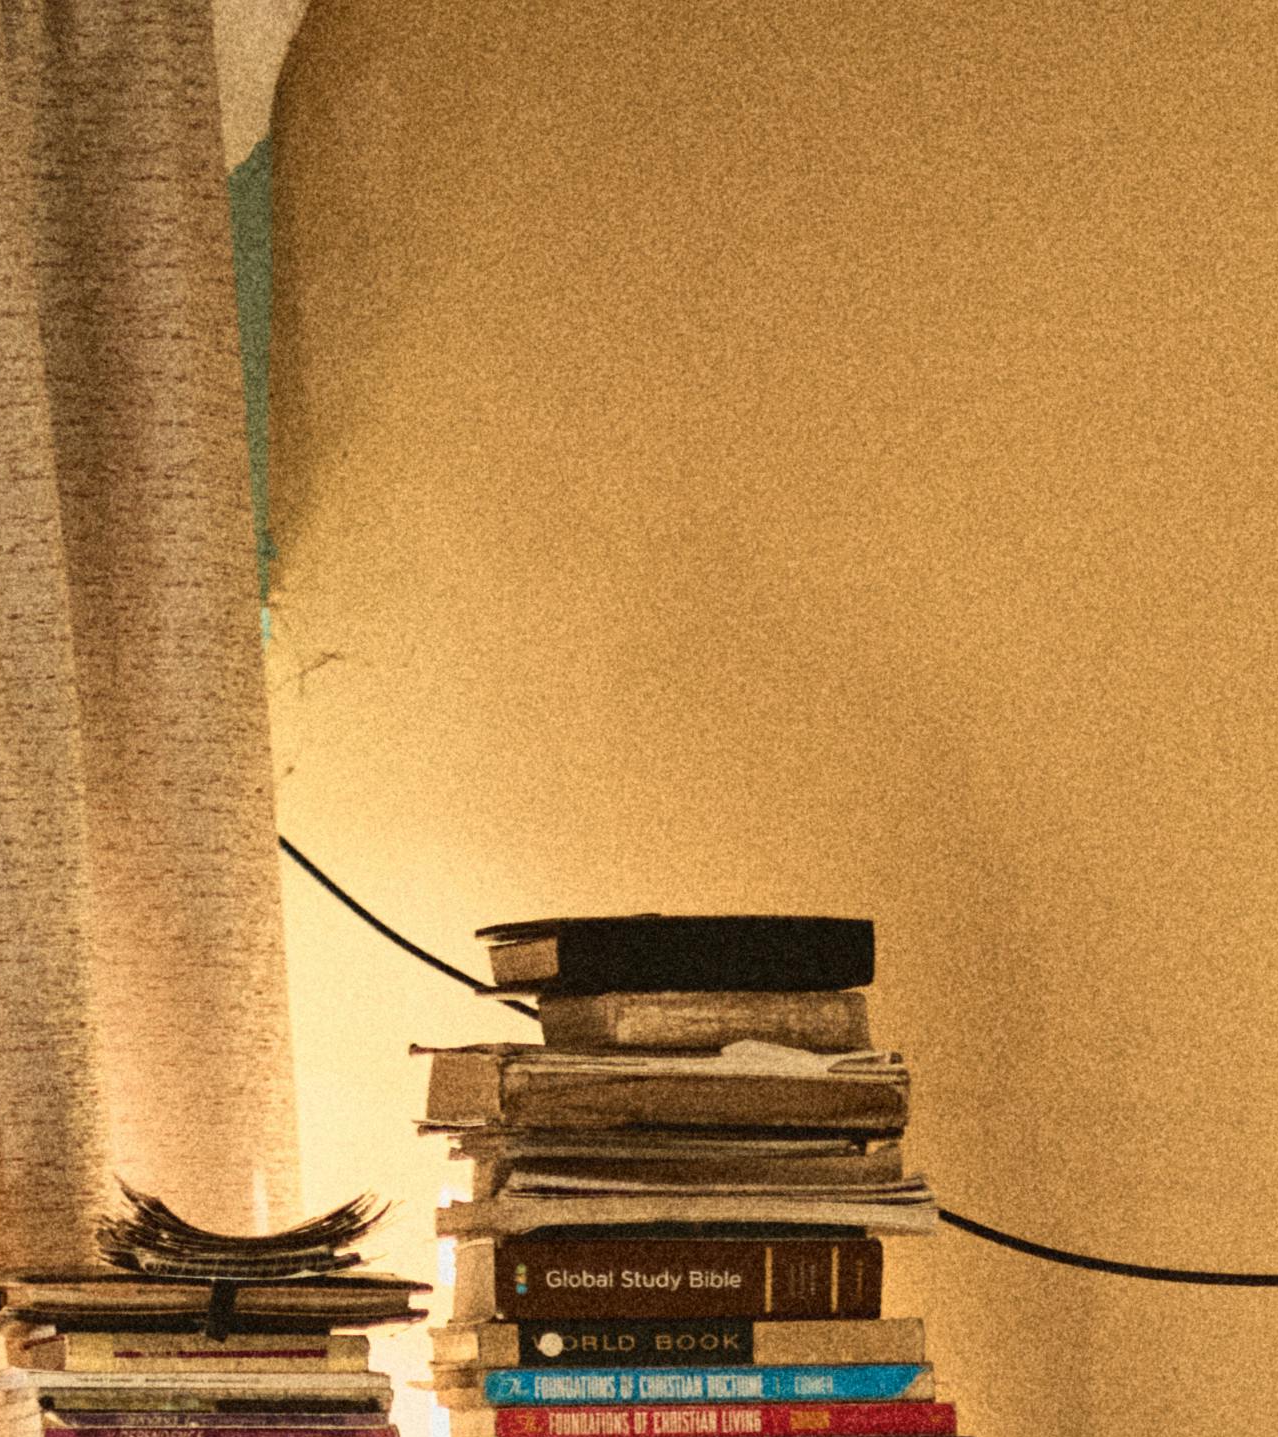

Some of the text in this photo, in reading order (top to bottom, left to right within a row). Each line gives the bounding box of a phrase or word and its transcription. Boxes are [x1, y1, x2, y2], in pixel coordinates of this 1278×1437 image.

[546, 1270, 742, 1293] Global Study Bible
[655, 1332, 741, 1353] BOOK
[534, 1376, 616, 1400] FOUNDATIONS
[639, 1375, 704, 1399] CHRISTIAN
[548, 1411, 762, 1436] FOUNDATIONS OF CHRISTIAN LIVING
